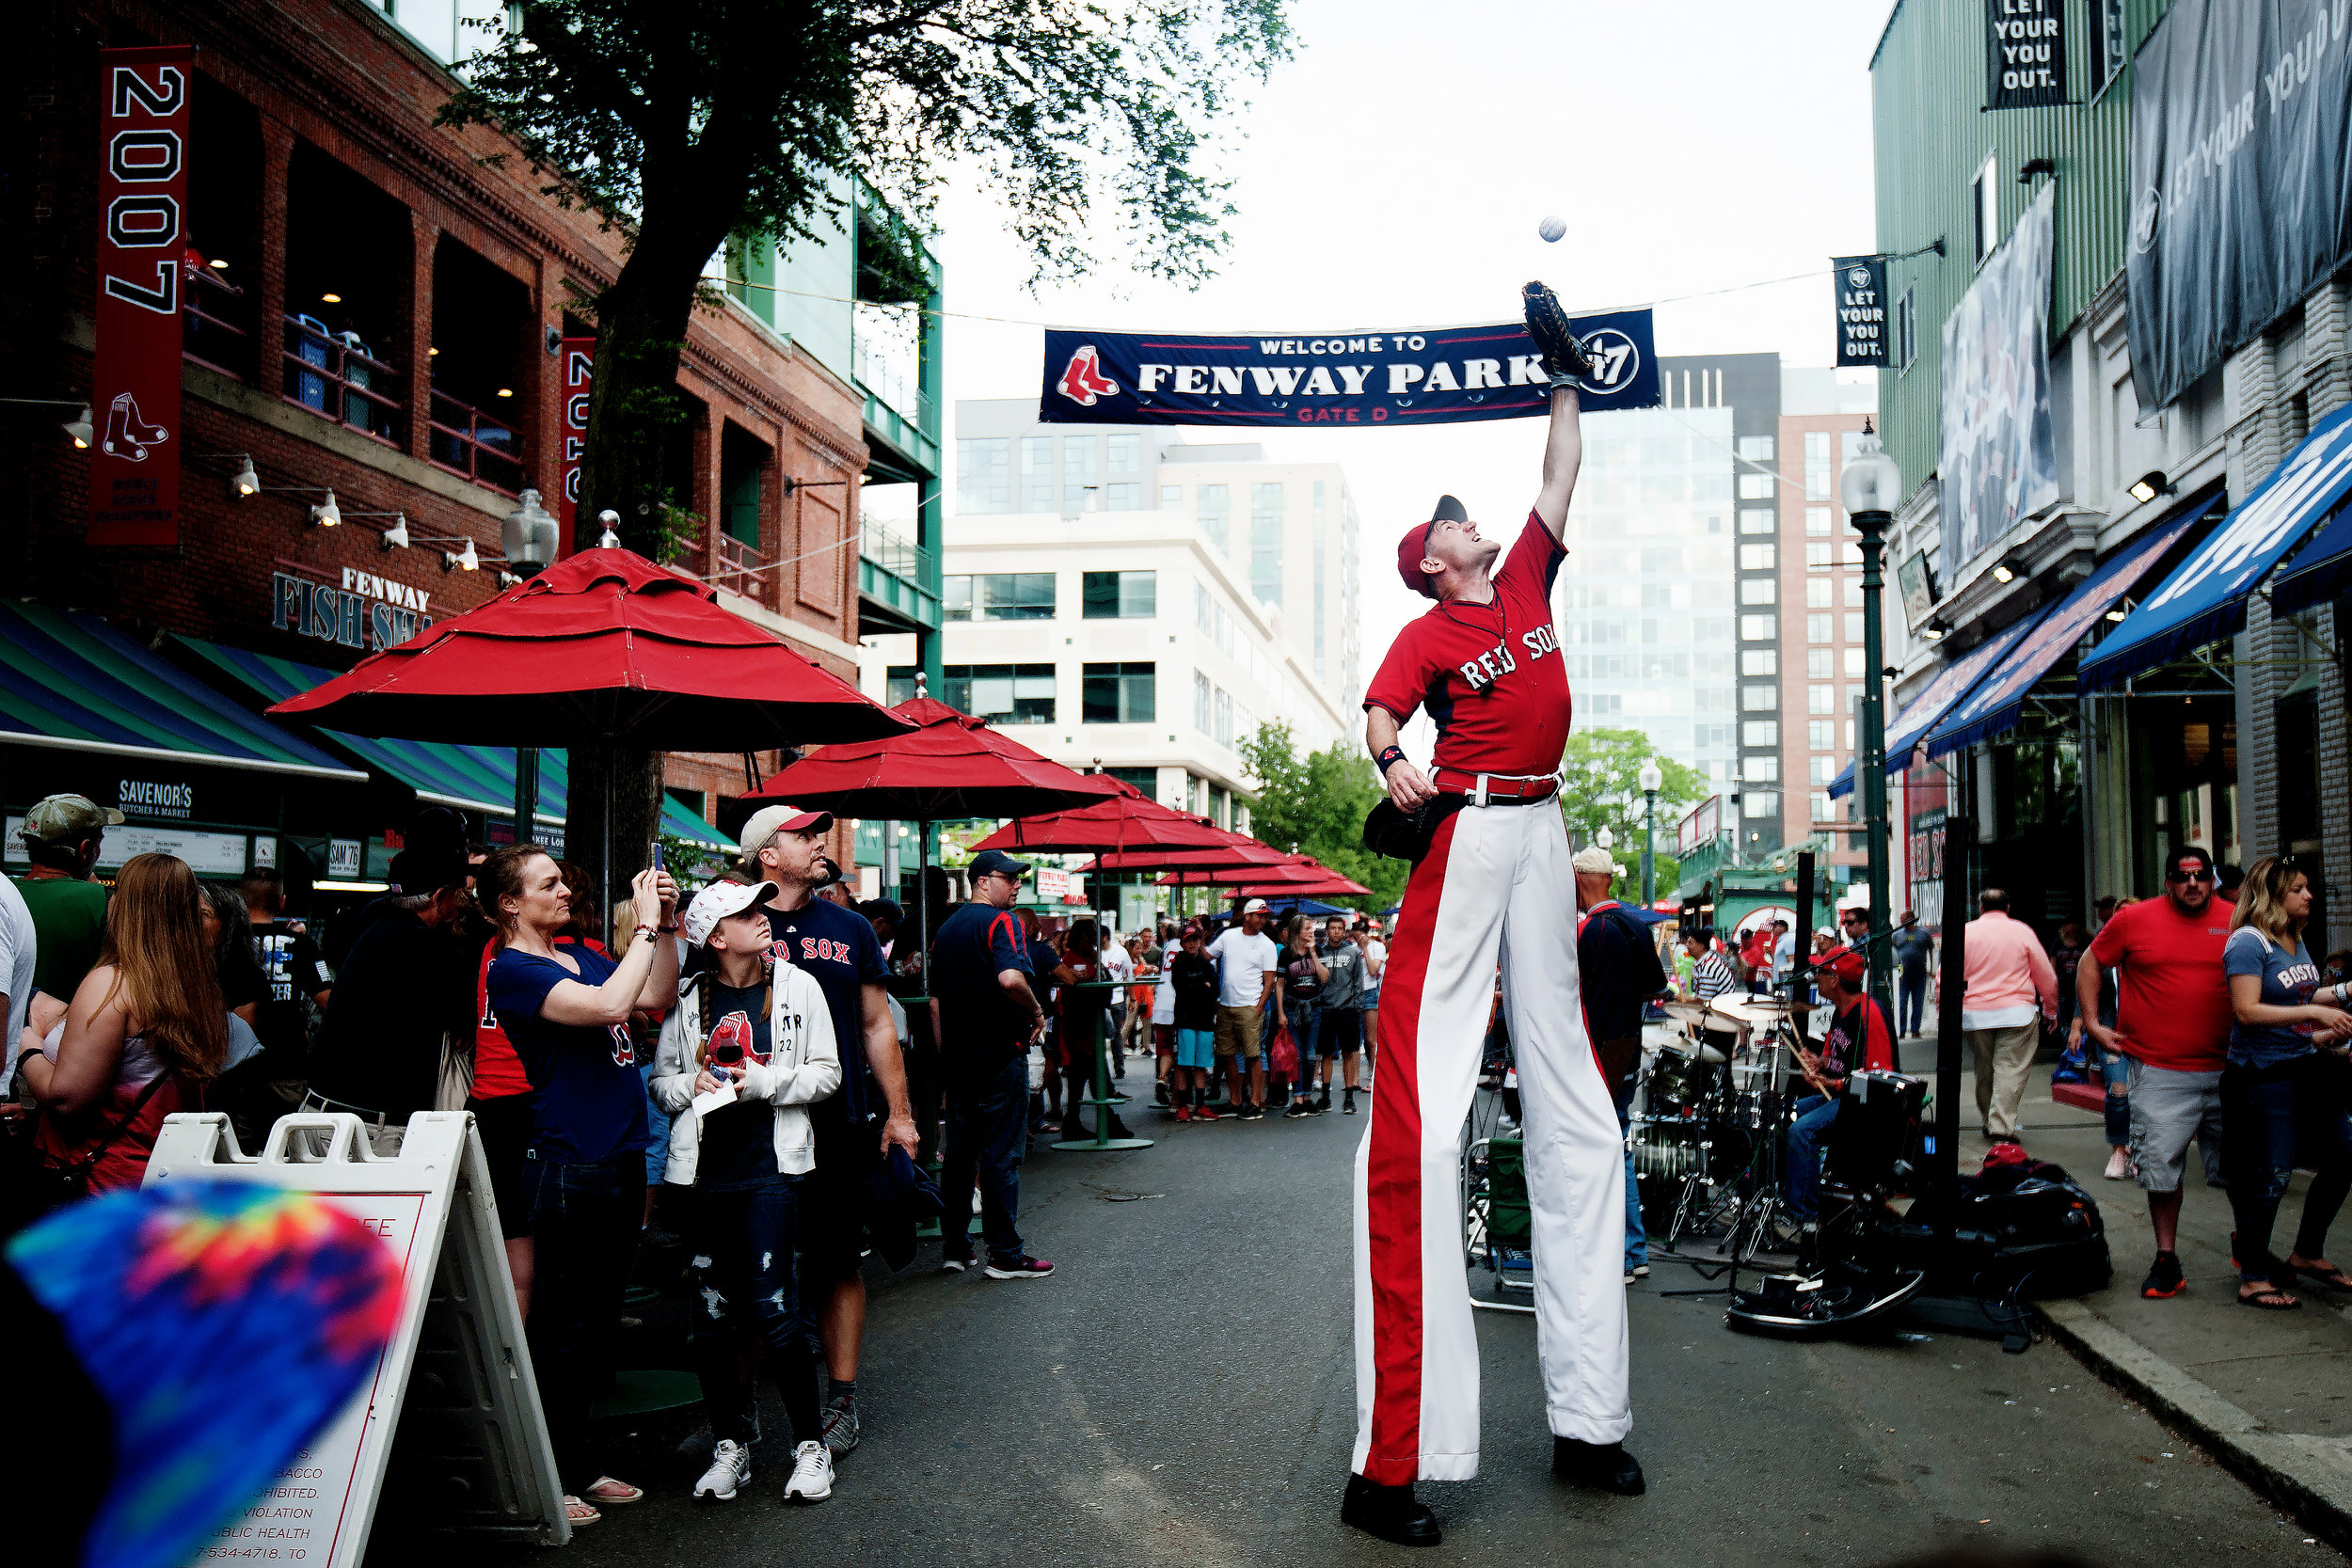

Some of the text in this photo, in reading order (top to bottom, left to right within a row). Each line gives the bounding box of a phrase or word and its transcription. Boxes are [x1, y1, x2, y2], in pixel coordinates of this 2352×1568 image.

[2003, 0, 2043, 14] LET
[1994, 18, 2058, 40] YOUR
[2003, 43, 2051, 64] YOU
[2003, 68, 2057, 89] OUT.
[2200, 89, 2255, 179] YOUR
[2264, 31, 2312, 115] YOU
[105, 67, 184, 314] 2007
[1845, 291, 1876, 306] LET
[1839, 308, 1883, 323] YOUR
[1846, 325, 1879, 340] YOU
[1259, 335, 1426, 356] WELCOME TO
[1846, 341, 1883, 356] OUT.
[1137, 353, 1551, 396] FENWAY PARK
[1297, 407, 1389, 422] GATE D
[342, 565, 430, 613] FENWAY
[272, 570, 365, 650] FISH
[1459, 644, 1518, 690] RED
[119, 779, 193, 808] SAVENOR'S
[119, 803, 153, 816] BUTCHER
[161, 807, 191, 819] MARKET
[330, 843, 347, 864] SAM
[760, 937, 852, 966] ED SOX
[2277, 963, 2321, 990] BOSTO
[779, 1038, 792, 1053] 22
[274, 1467, 323, 1480] BACCO
[243, 1507, 314, 1519] VIOLATION
[211, 1527, 310, 1540] UBLIC HEALTH
[289, 1548, 307, 1560] TO
